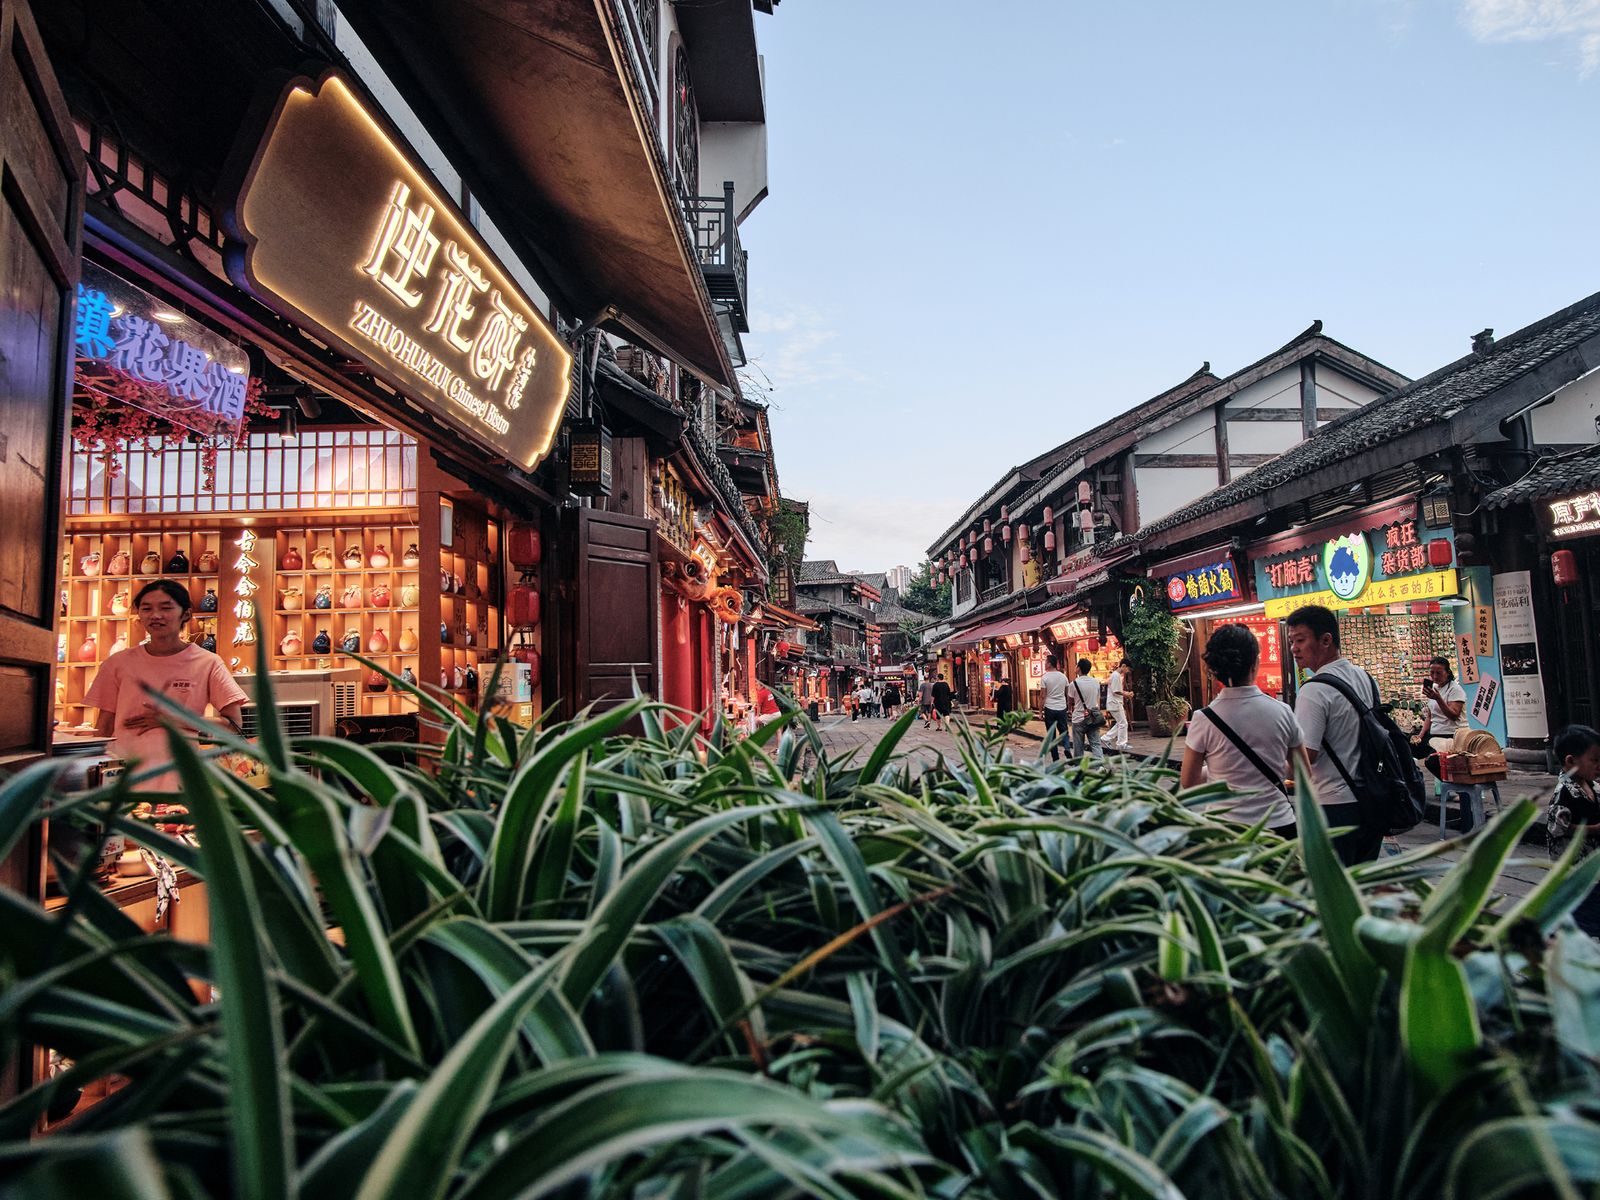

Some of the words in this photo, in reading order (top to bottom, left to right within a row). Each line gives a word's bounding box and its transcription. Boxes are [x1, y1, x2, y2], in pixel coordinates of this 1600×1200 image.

[352, 303, 453, 390] ZHUOHUAZUI
[485, 403, 510, 435] Bistro
[1385, 521, 1417, 549] 疯狂
[1381, 543, 1426, 575] 杂货部
